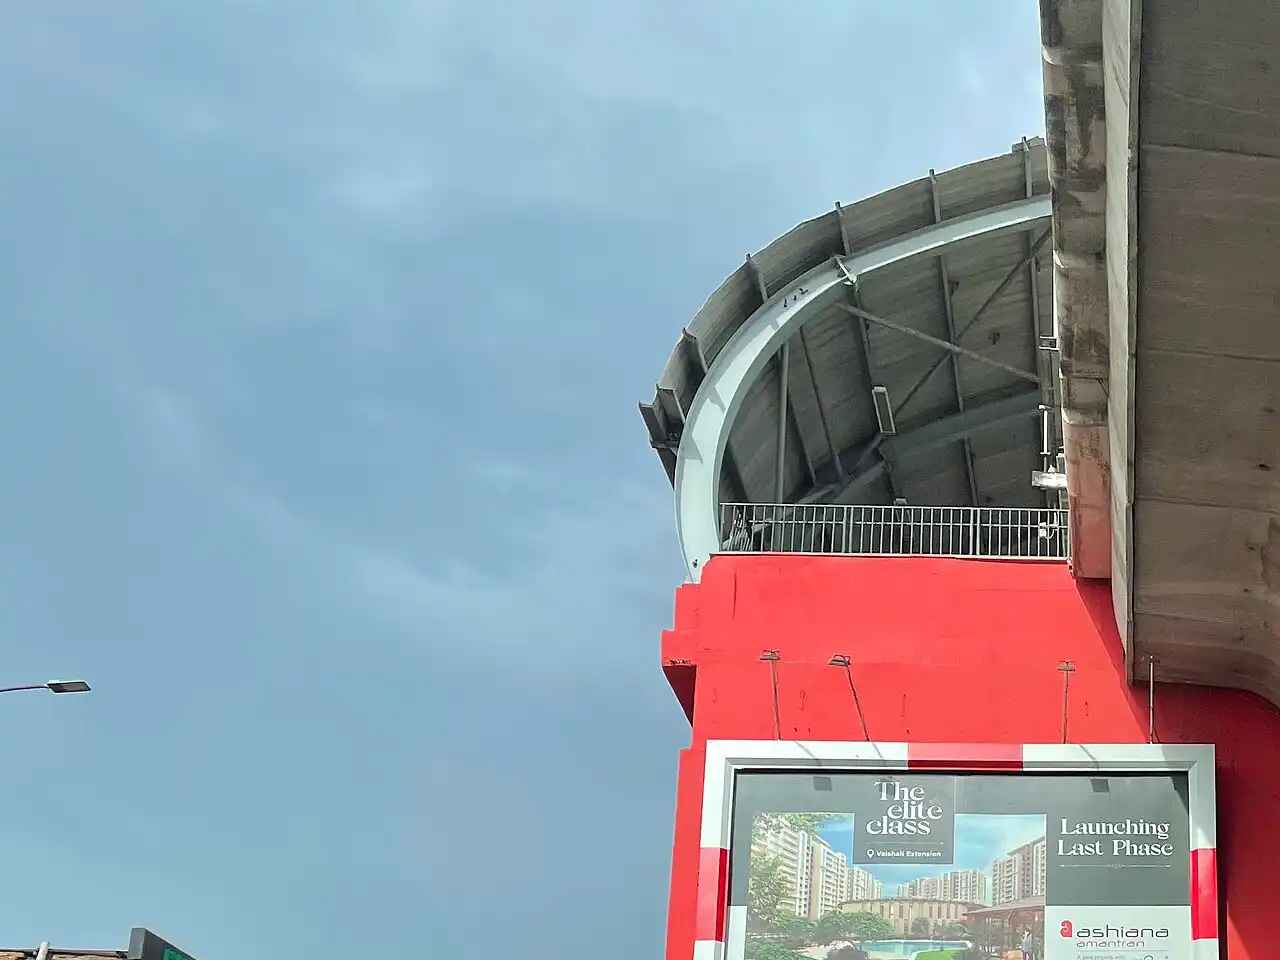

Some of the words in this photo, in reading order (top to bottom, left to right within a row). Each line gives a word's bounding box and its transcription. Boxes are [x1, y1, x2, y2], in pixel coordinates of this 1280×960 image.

[874, 781, 925, 801] The
[887, 800, 943, 820] elite
[866, 816, 931, 835] class
[1060, 818, 1170, 840] Launching
[906, 849, 942, 857] Extension
[1057, 839, 1104, 856] Last
[1112, 839, 1174, 856] Phase
[1076, 924, 1169, 938] ashiana
[1076, 939, 1145, 948] amantran
